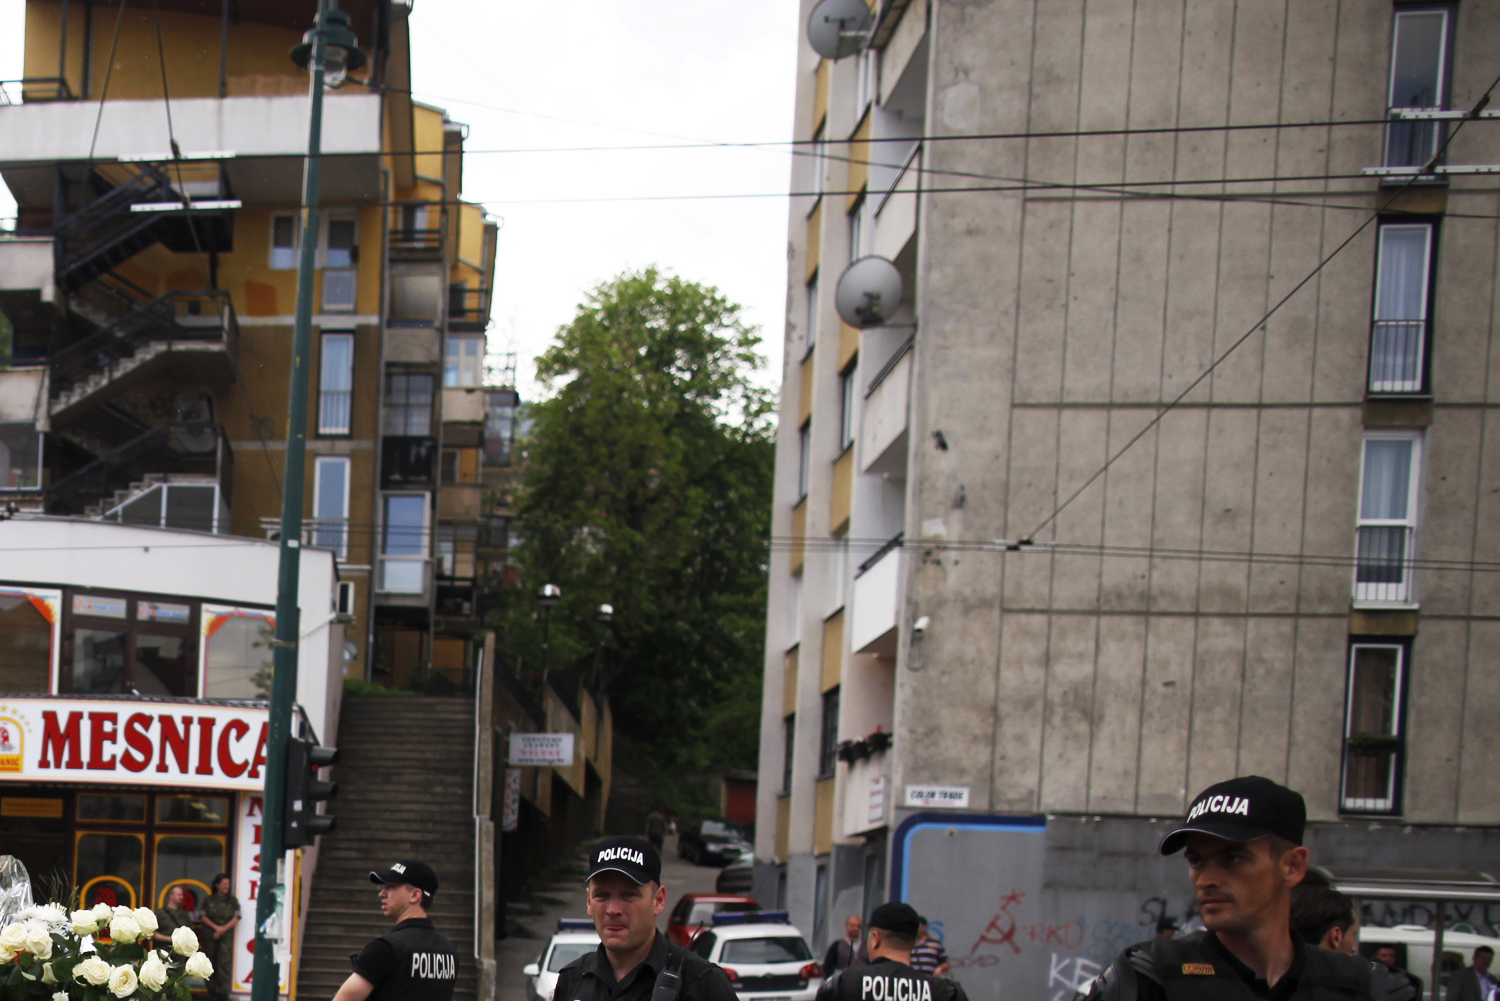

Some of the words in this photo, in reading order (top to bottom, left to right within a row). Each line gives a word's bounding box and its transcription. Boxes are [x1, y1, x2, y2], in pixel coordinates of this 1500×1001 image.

[1186, 795, 1250, 824] POLICIJA
[598, 847, 644, 866] POLICIJA
[411, 952, 455, 980] POLICIJA
